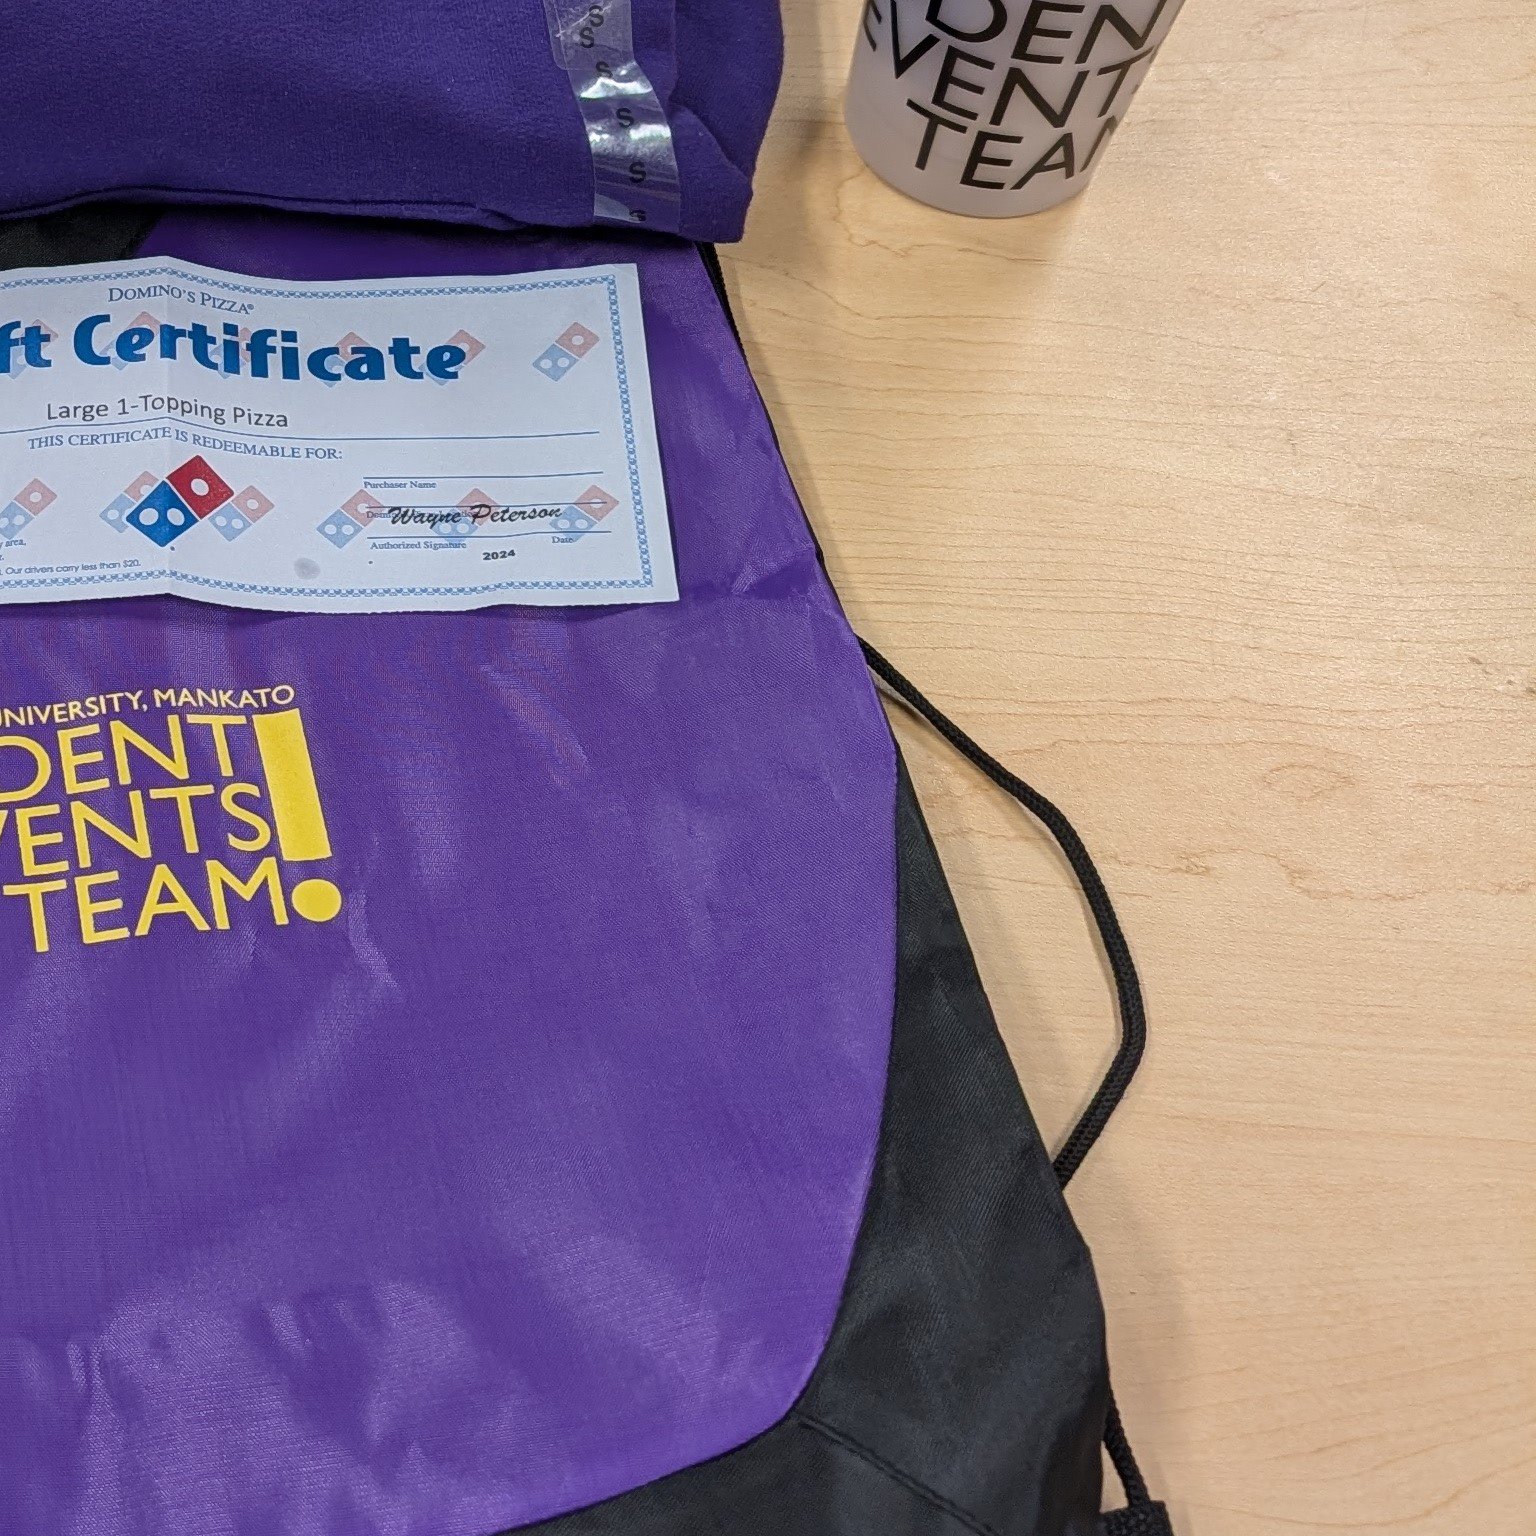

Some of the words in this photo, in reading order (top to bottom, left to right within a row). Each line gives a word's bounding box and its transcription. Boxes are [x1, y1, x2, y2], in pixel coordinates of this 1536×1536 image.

[73, 314, 467, 382] Certificate
[47, 402, 109, 422] Large
[117, 394, 225, 425] 1-Topping
[233, 406, 289, 428] Pizza
[28, 434, 64, 449] THIS
[68, 426, 172, 446] CERTIFICATE
[175, 429, 188, 442] IS
[192, 431, 301, 459] REDEEMABLE
[305, 447, 343, 460] FOR:
[363, 481, 408, 489] Purchaser
[410, 481, 437, 489] Name
[388, 506, 462, 529] Wayne
[470, 504, 563, 524] Peterson
[370, 541, 421, 550] Authorized
[423, 541, 467, 551] Signature
[482, 549, 516, 560] 2024
[5, 566, 22, 575] Our
[25, 564, 54, 574] drivers
[56, 565, 79, 573] carry
[99, 562, 121, 570] than
[153, 684, 295, 709] MANKATO
